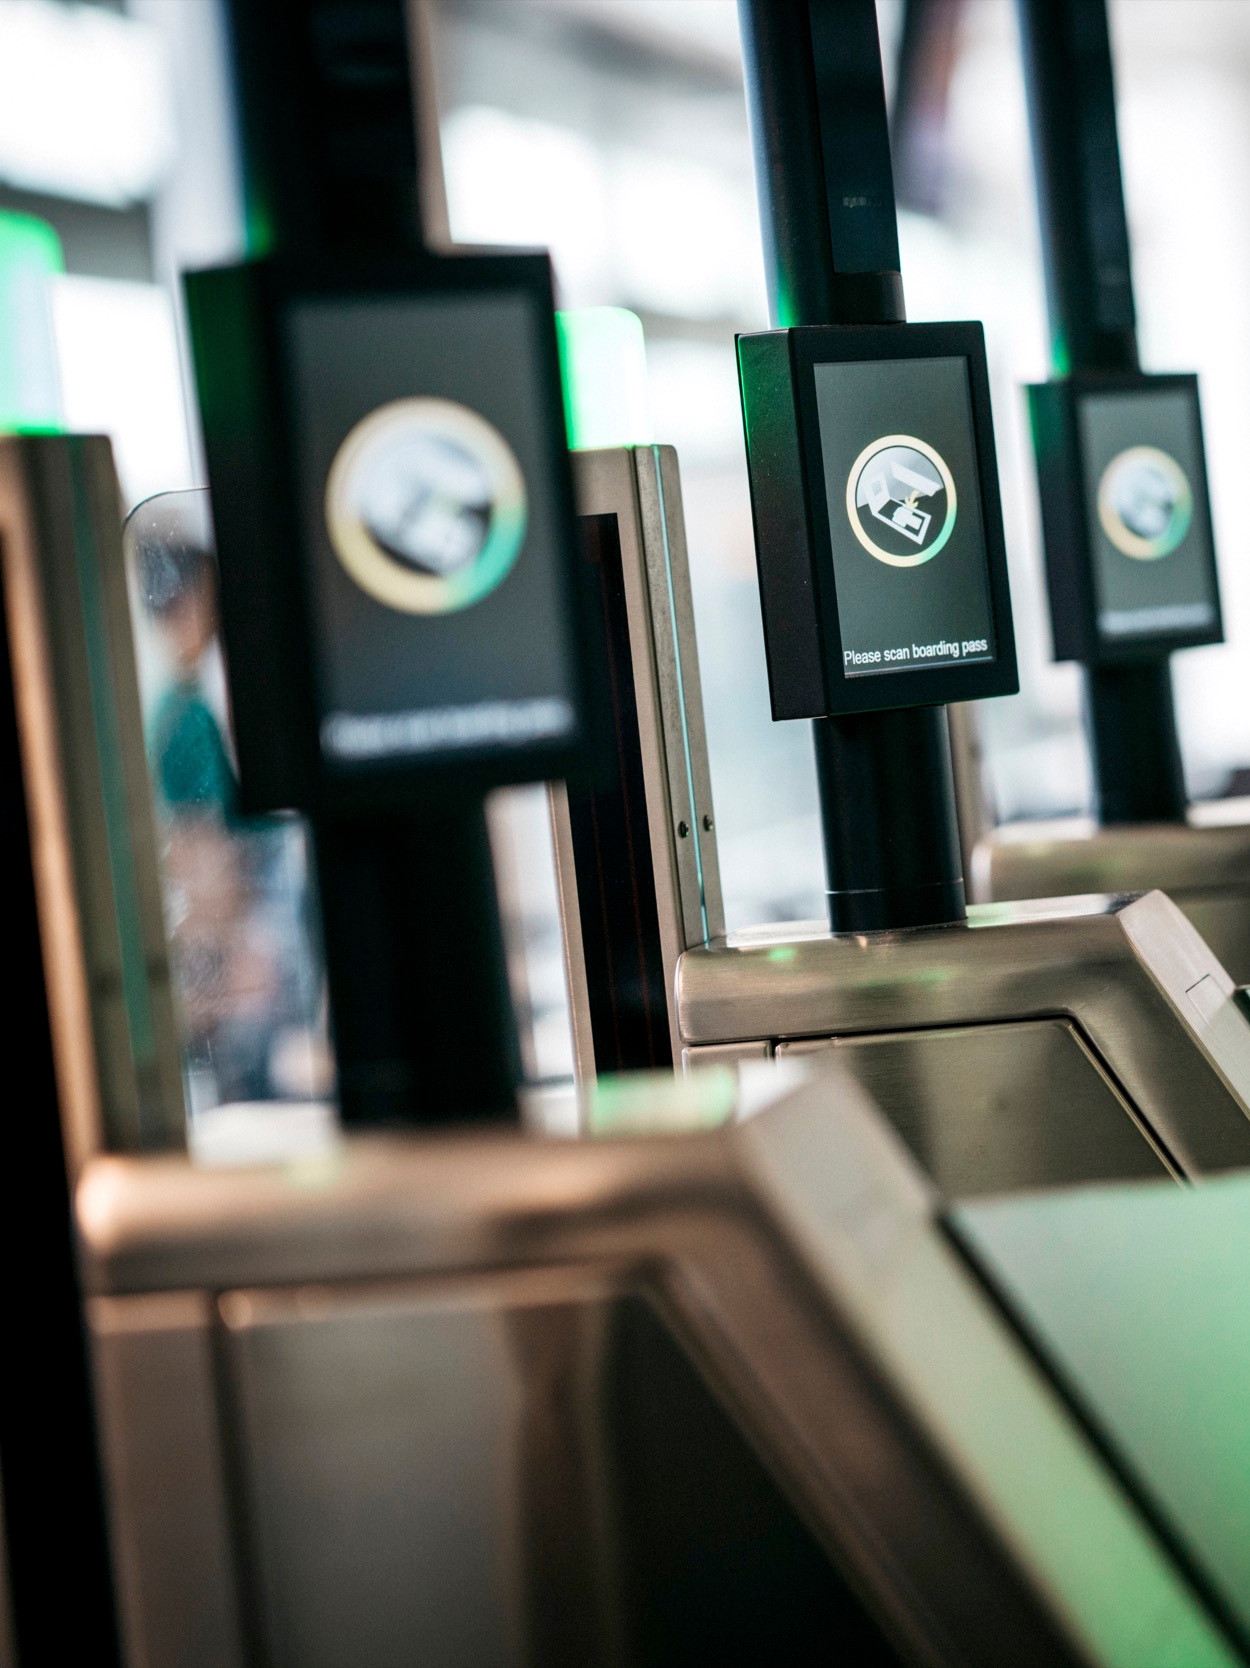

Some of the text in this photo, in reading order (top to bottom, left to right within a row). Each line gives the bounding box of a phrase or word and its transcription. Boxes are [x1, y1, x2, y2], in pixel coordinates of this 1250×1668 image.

[844, 639, 988, 665] Please scan boarding pass
